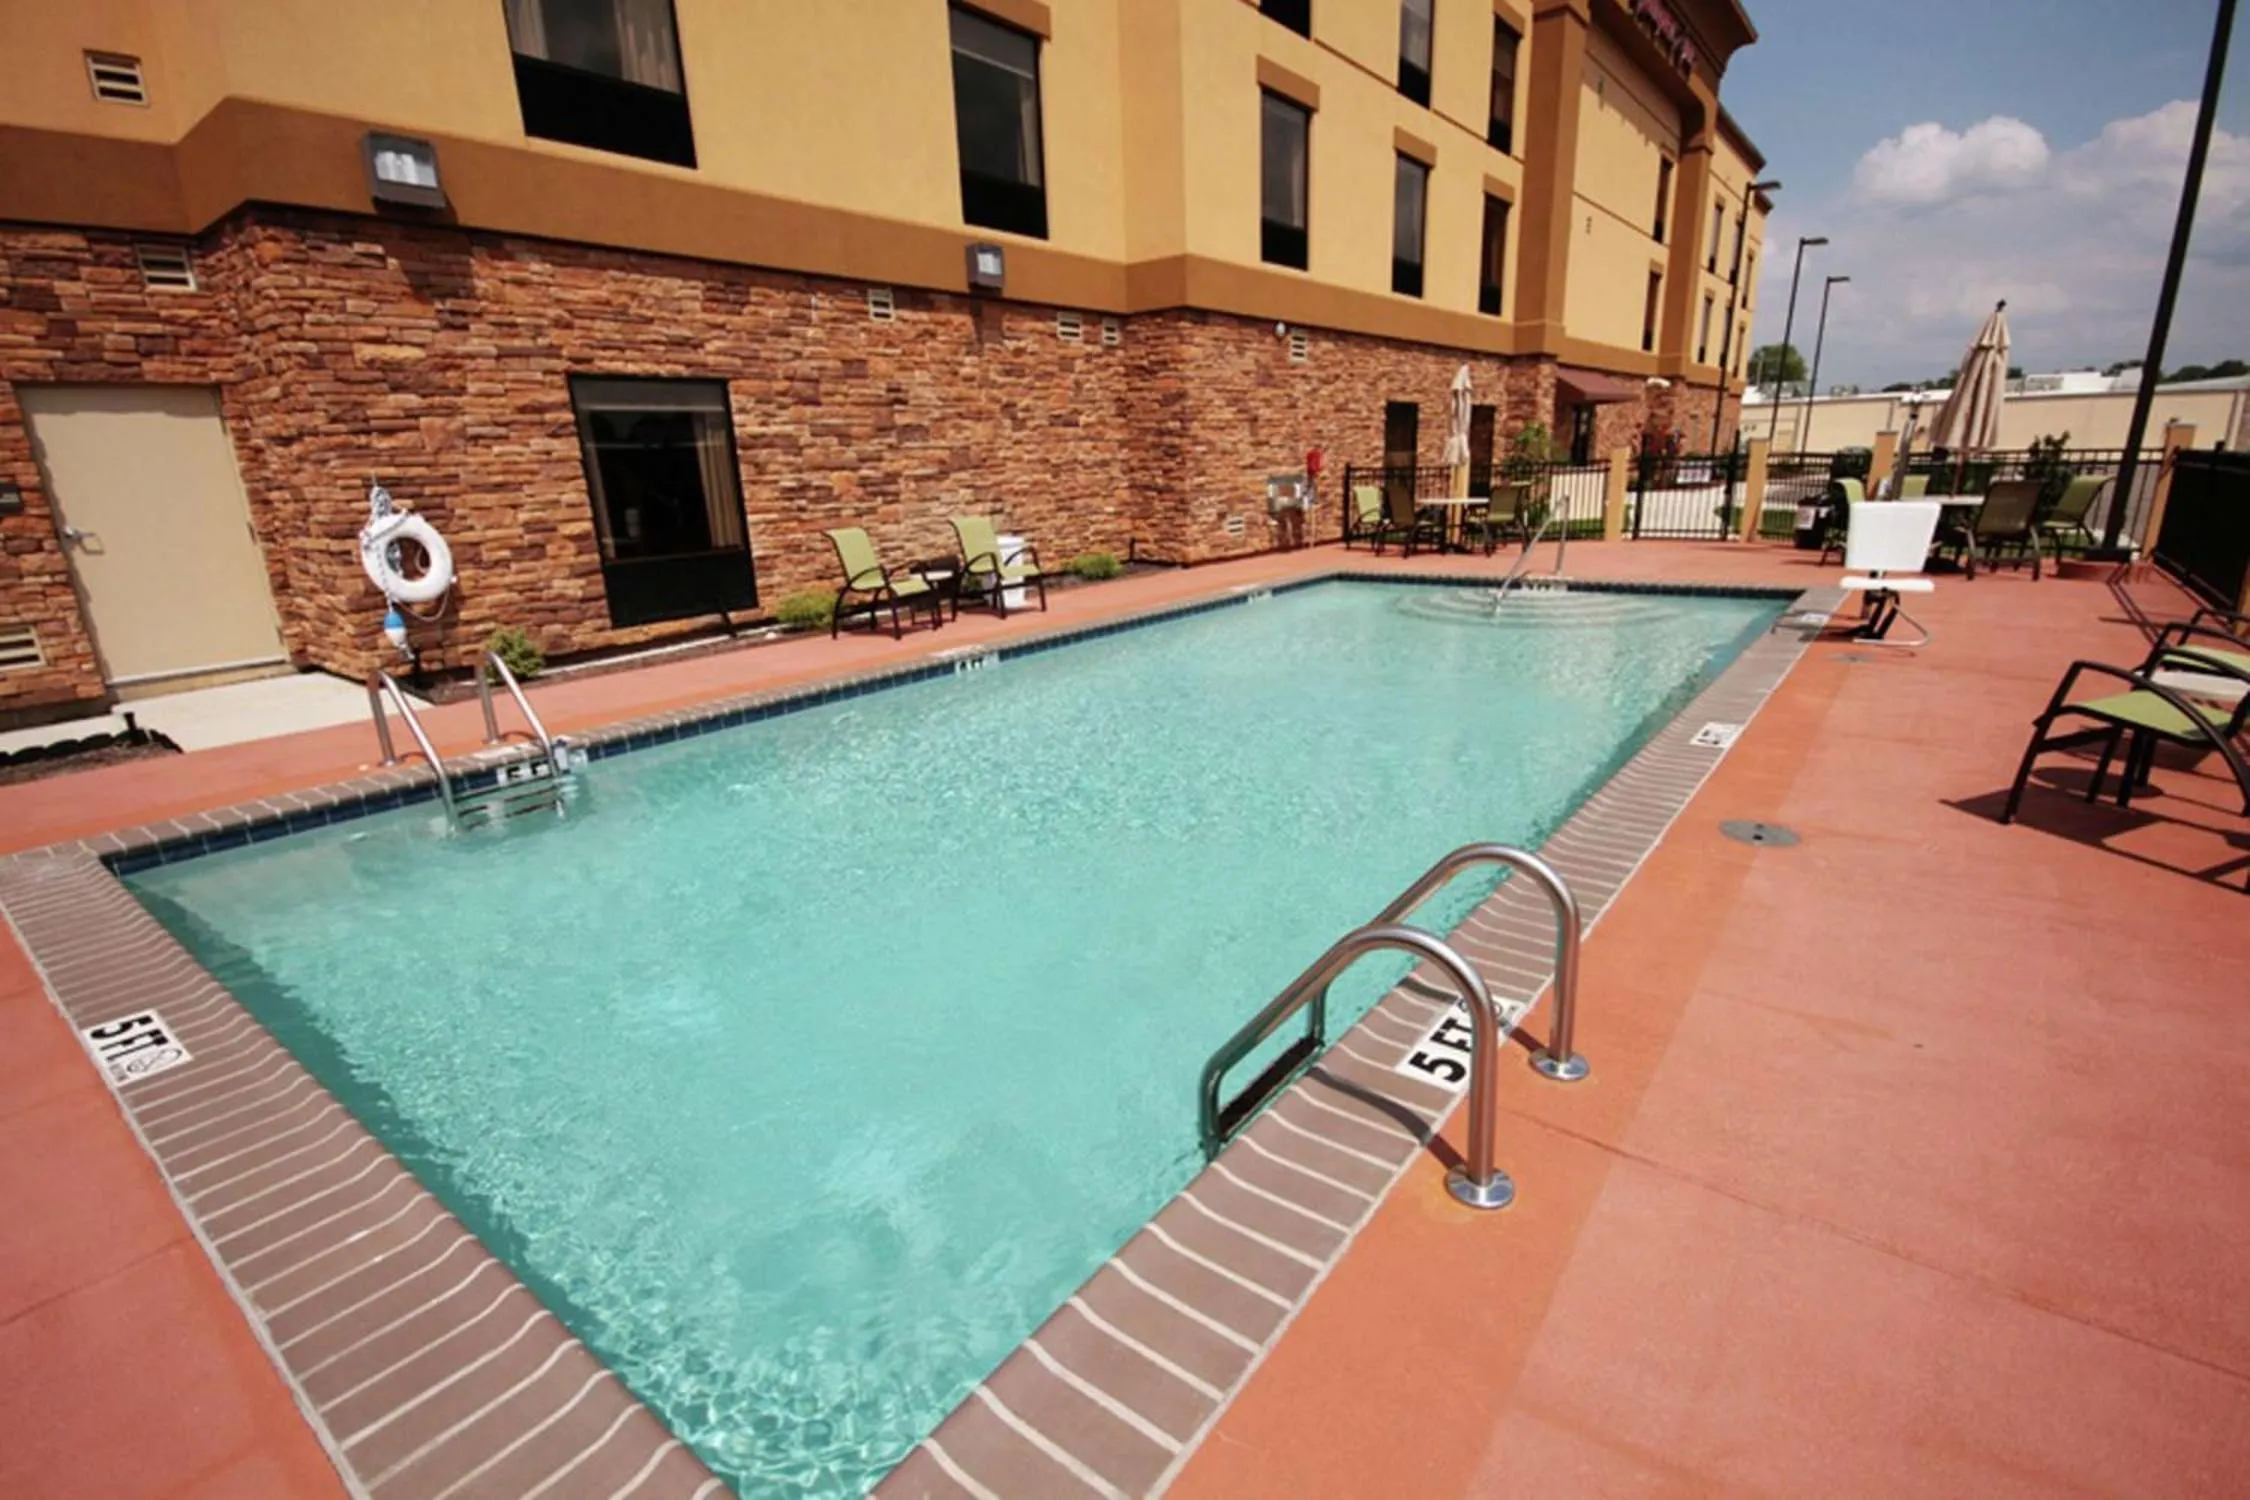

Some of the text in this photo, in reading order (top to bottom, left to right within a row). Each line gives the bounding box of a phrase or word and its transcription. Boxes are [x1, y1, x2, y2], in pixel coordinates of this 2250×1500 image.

[90, 1015, 169, 1061] 5 FT
[1408, 1016, 1474, 1083] 5 FT
